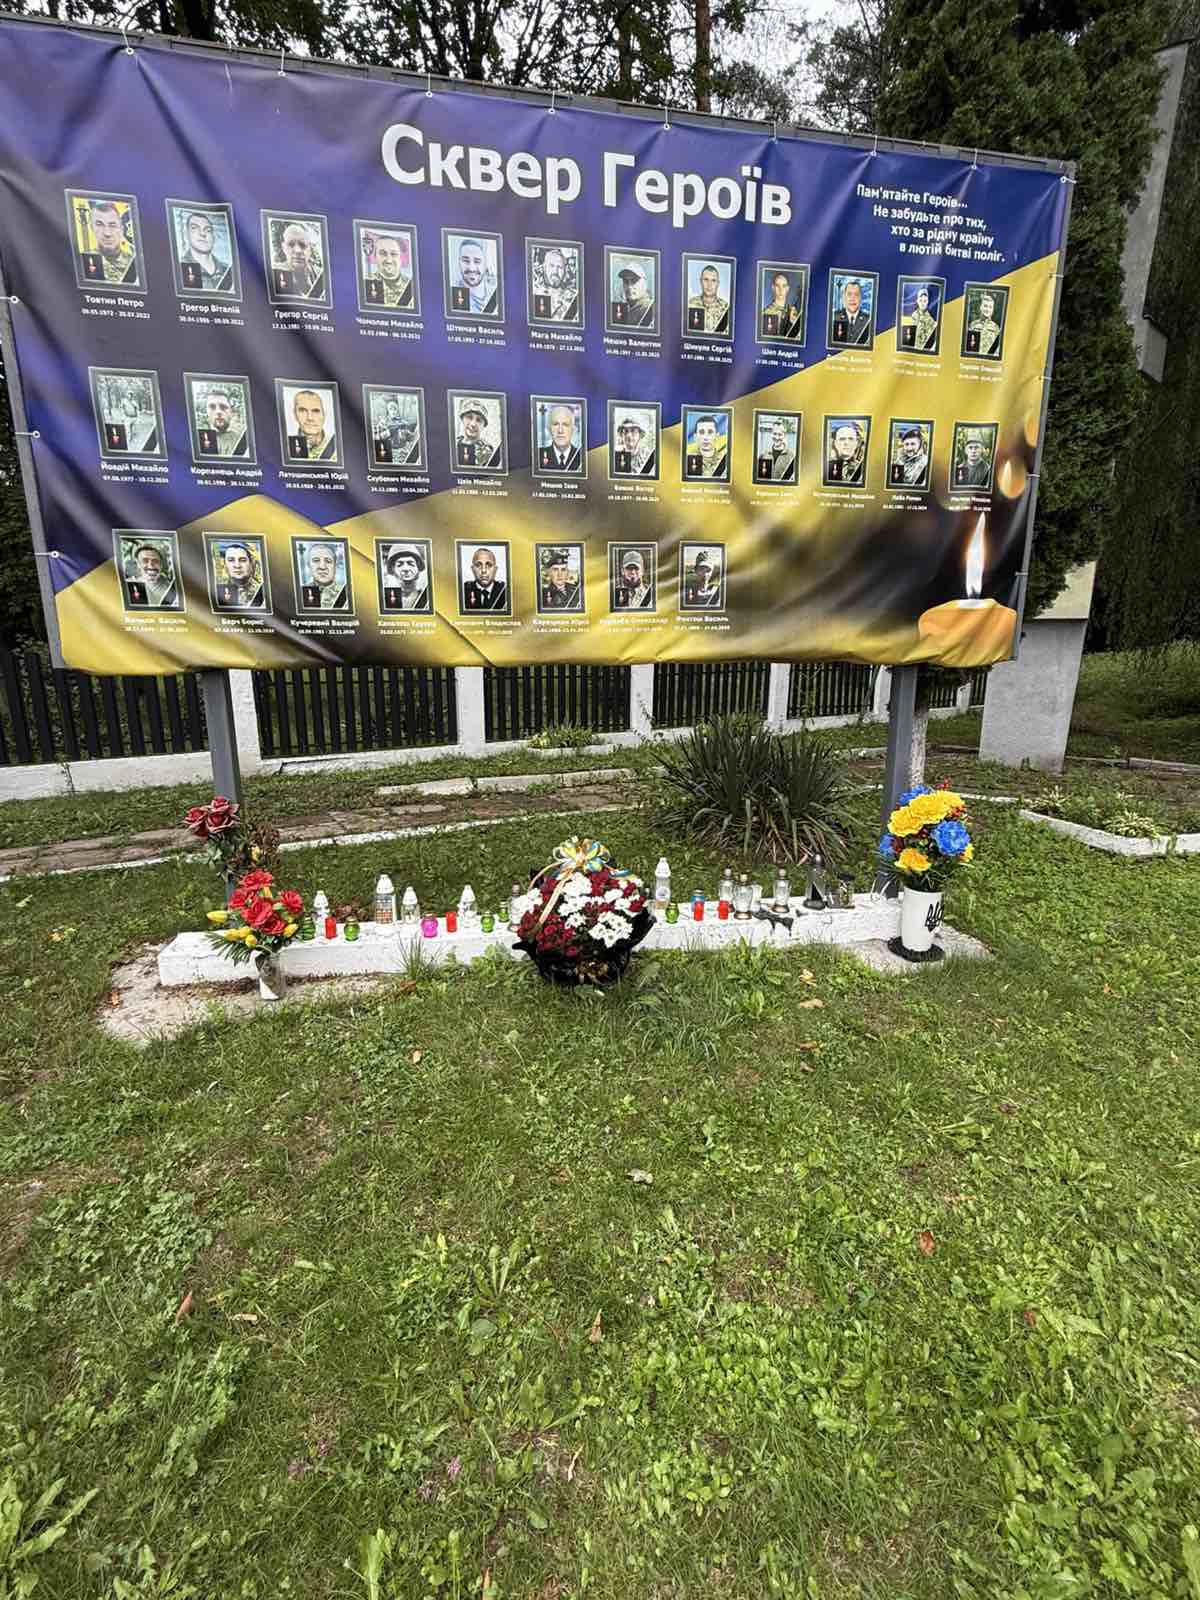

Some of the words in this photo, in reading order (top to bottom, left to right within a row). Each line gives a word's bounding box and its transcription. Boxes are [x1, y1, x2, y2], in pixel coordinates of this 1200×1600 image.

[380, 122, 582, 215] Сквер
[602, 151, 793, 229] Героїв
[856, 183, 921, 203] Пам'ятайте
[923, 192, 968, 209] Героїв...
[873, 205, 889, 218] Не
[890, 207, 941, 225] забудьте
[943, 214, 964, 226] про
[965, 217, 987, 231] тих,
[891, 224, 911, 236] хто
[912, 228, 925, 239] за
[927, 228, 958, 243] рідну
[959, 232, 994, 249] країну
[899, 243, 906, 252] в
[909, 243, 942, 256] лютій
[945, 244, 972, 260] битві
[974, 249, 1006, 263] поліг.
[117, 297, 145, 308] Петро
[180, 302, 210, 314] Грегор
[210, 304, 241, 314] Віталій
[274, 310, 301, 319] Грегор
[302, 311, 329, 321] Сергій
[390, 319, 425, 329] Михайло
[478, 326, 505, 335] Василь
[550, 332, 583, 342] Михайло
[628, 339, 662, 347] Валентин
[711, 345, 733, 354] Сергій
[777, 350, 799, 359] Андрій
[131, 463, 169, 473] Михайло
[235, 468, 263, 477] Андрій
[330, 472, 349, 481] Юрій
[400, 476, 430, 484] Михайло
